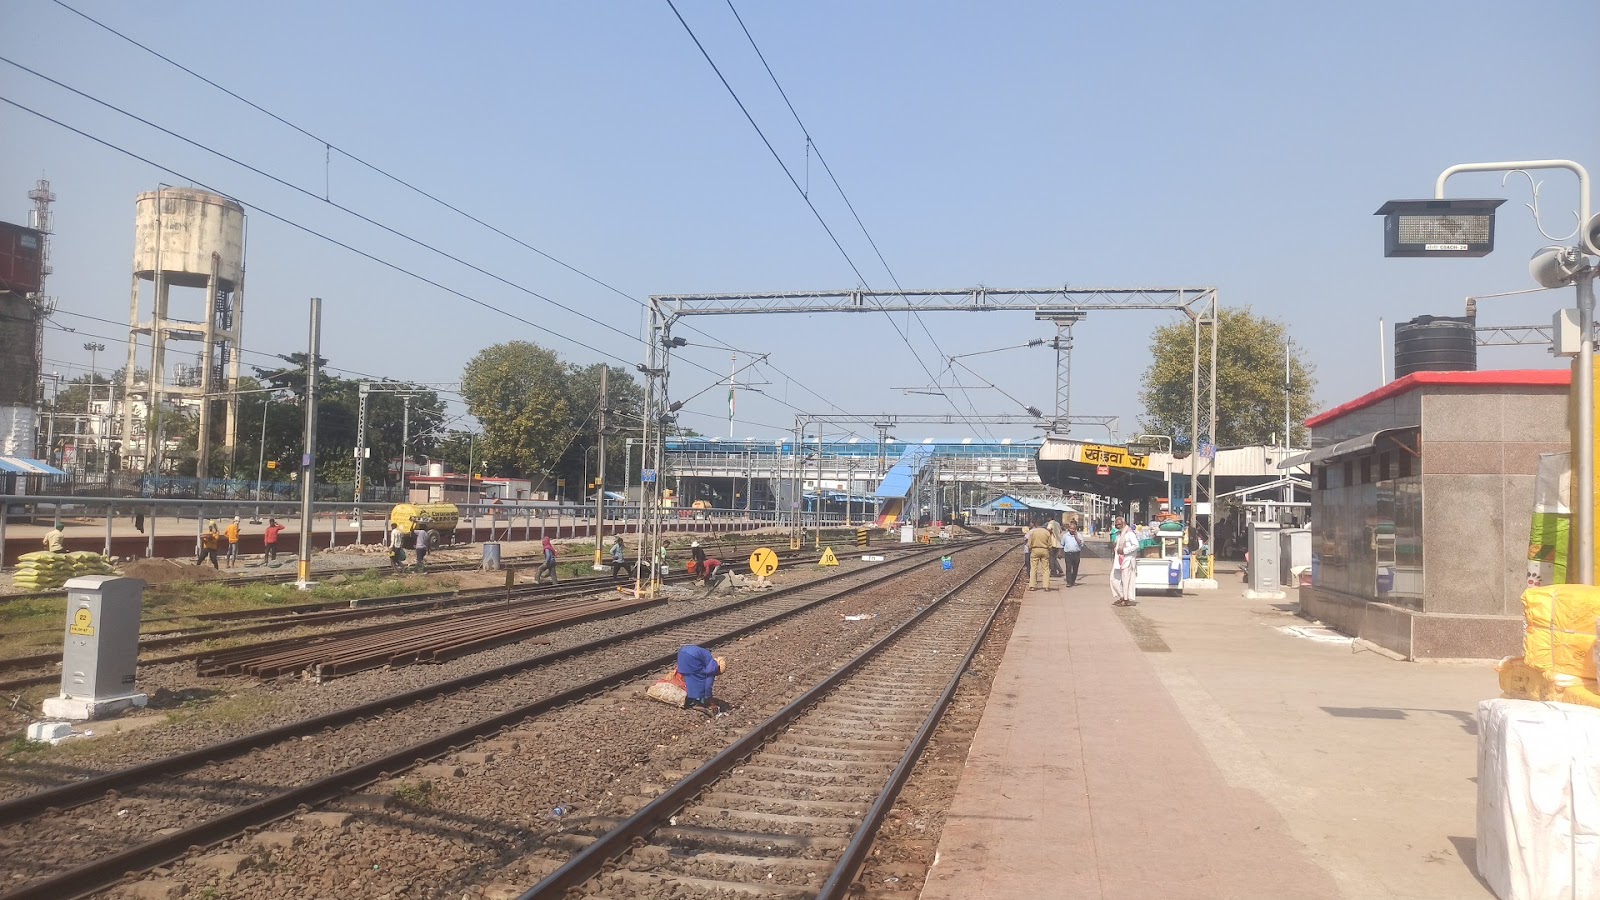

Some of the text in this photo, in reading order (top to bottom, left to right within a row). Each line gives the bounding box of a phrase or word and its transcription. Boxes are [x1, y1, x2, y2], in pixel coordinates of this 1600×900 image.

[1085, 446, 1125, 464] खंडवा
[753, 552, 762, 562] T
[825, 554, 834, 562] 10
[765, 564, 774, 574] P
